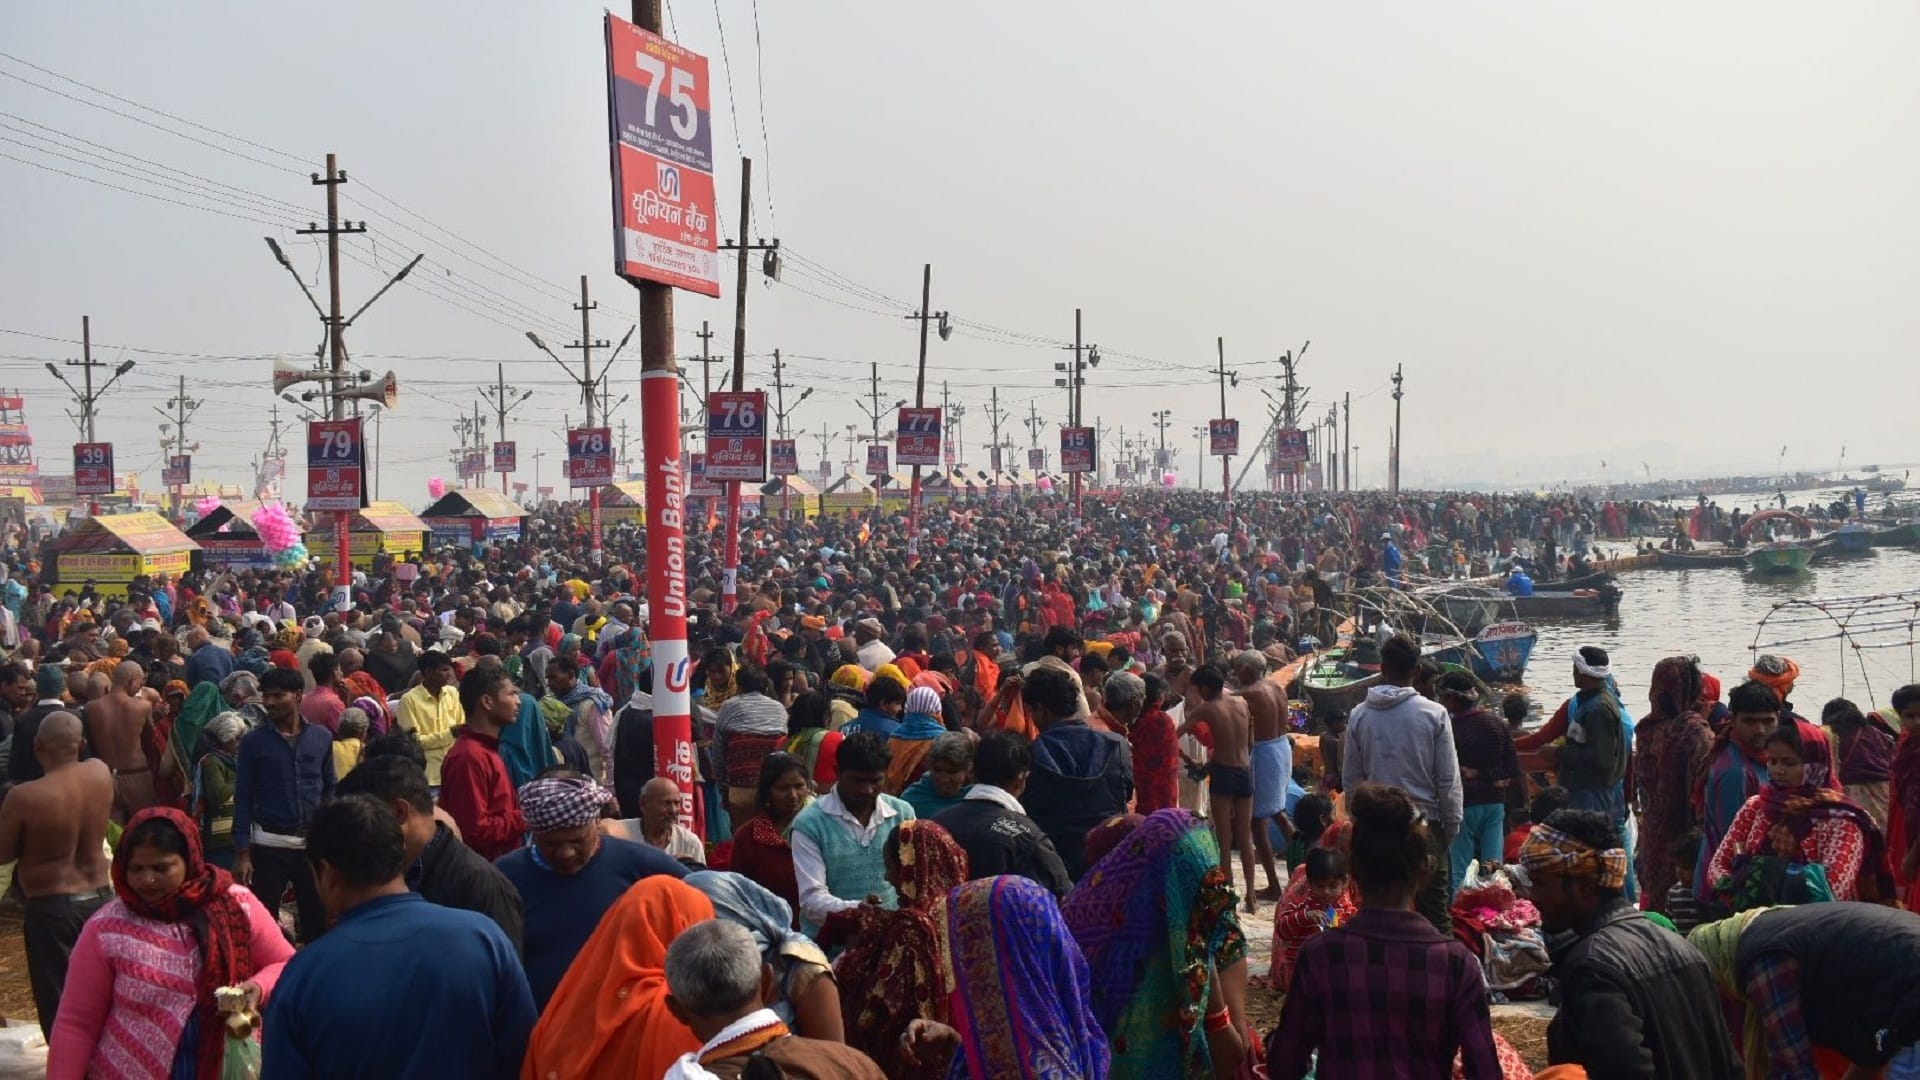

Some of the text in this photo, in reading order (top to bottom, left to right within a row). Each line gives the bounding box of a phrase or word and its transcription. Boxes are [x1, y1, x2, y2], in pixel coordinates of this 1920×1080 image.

[636, 50, 698, 141] 75
[632, 189, 709, 232] यूनियन बैंक
[720, 401, 756, 428] 76
[908, 413, 935, 432] 77
[1214, 423, 1233, 434] 14
[319, 430, 352, 458] 79
[577, 434, 604, 453] 78
[775, 443, 792, 454] 17
[1067, 432, 1085, 447] 15
[82, 447, 105, 464] 39
[497, 445, 510, 455] 37
[659, 456, 685, 617] Union Bank
[666, 739, 691, 783] बैंक
